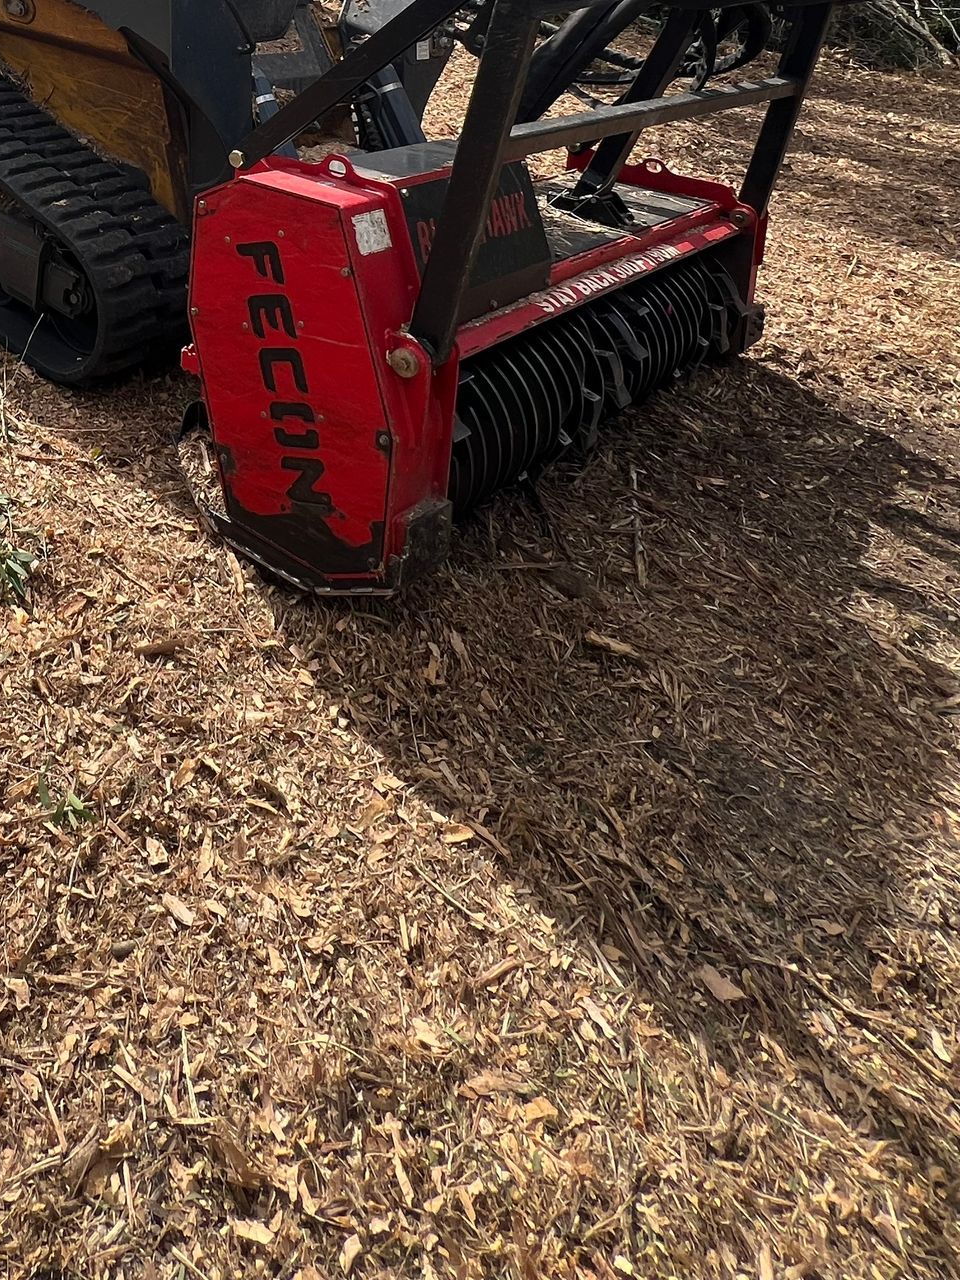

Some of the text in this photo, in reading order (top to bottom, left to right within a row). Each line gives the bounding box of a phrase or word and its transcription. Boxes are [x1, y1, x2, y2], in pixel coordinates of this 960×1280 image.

[535, 286, 578, 313] STAY
[571, 270, 620, 296] BACK
[236, 241, 332, 506] FECON
